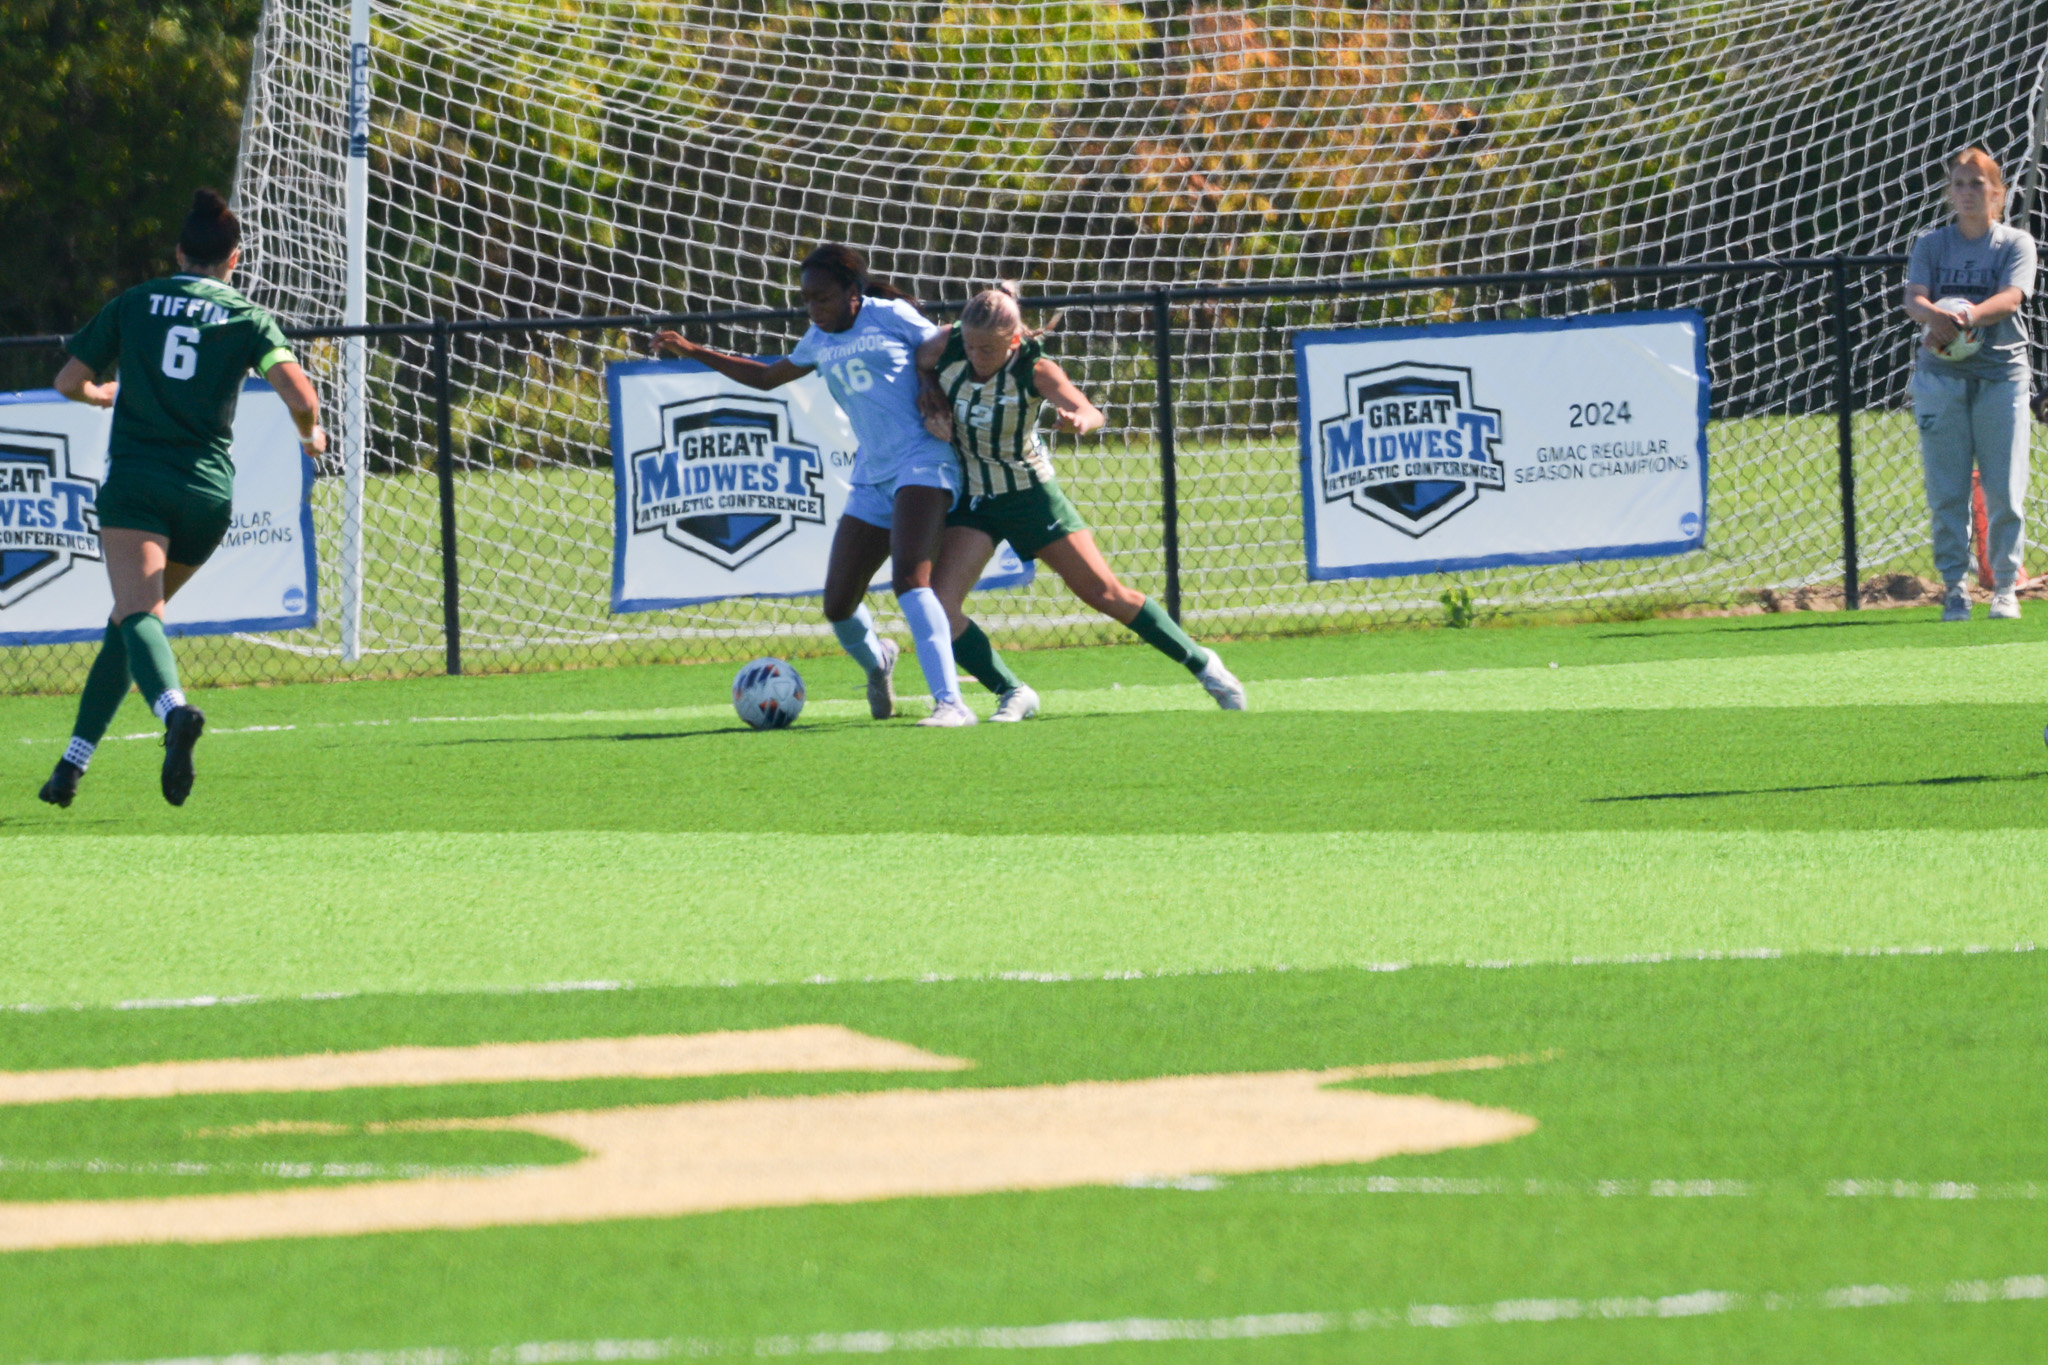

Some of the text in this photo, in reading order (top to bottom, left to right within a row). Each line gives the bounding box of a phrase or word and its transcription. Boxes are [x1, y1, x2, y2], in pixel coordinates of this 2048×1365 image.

[150, 293, 230, 324] TIFFIN
[161, 325, 201, 381] 6
[831, 358, 874, 396] 16
[955, 398, 993, 431] 12
[1369, 400, 1451, 428] GREAT
[1569, 401, 1632, 428] 2024
[683, 432, 768, 461] GREAT
[1327, 411, 1496, 475] MIDWEST
[1536, 439, 1669, 463] GMAC REGULAR
[830, 450, 856, 467] GM
[1514, 454, 1690, 484] SEASON CHAMPIONS
[0, 467, 46, 494] EAT
[639, 446, 816, 505] MIDWEST
[1328, 461, 1499, 492] ATHLETIC CONFERENCE
[0, 481, 94, 533] WEST
[229, 511, 272, 529] ULAR
[641, 494, 818, 523] ATHLETIC CONFERENCE
[0, 530, 96, 552] ONFERENCE
